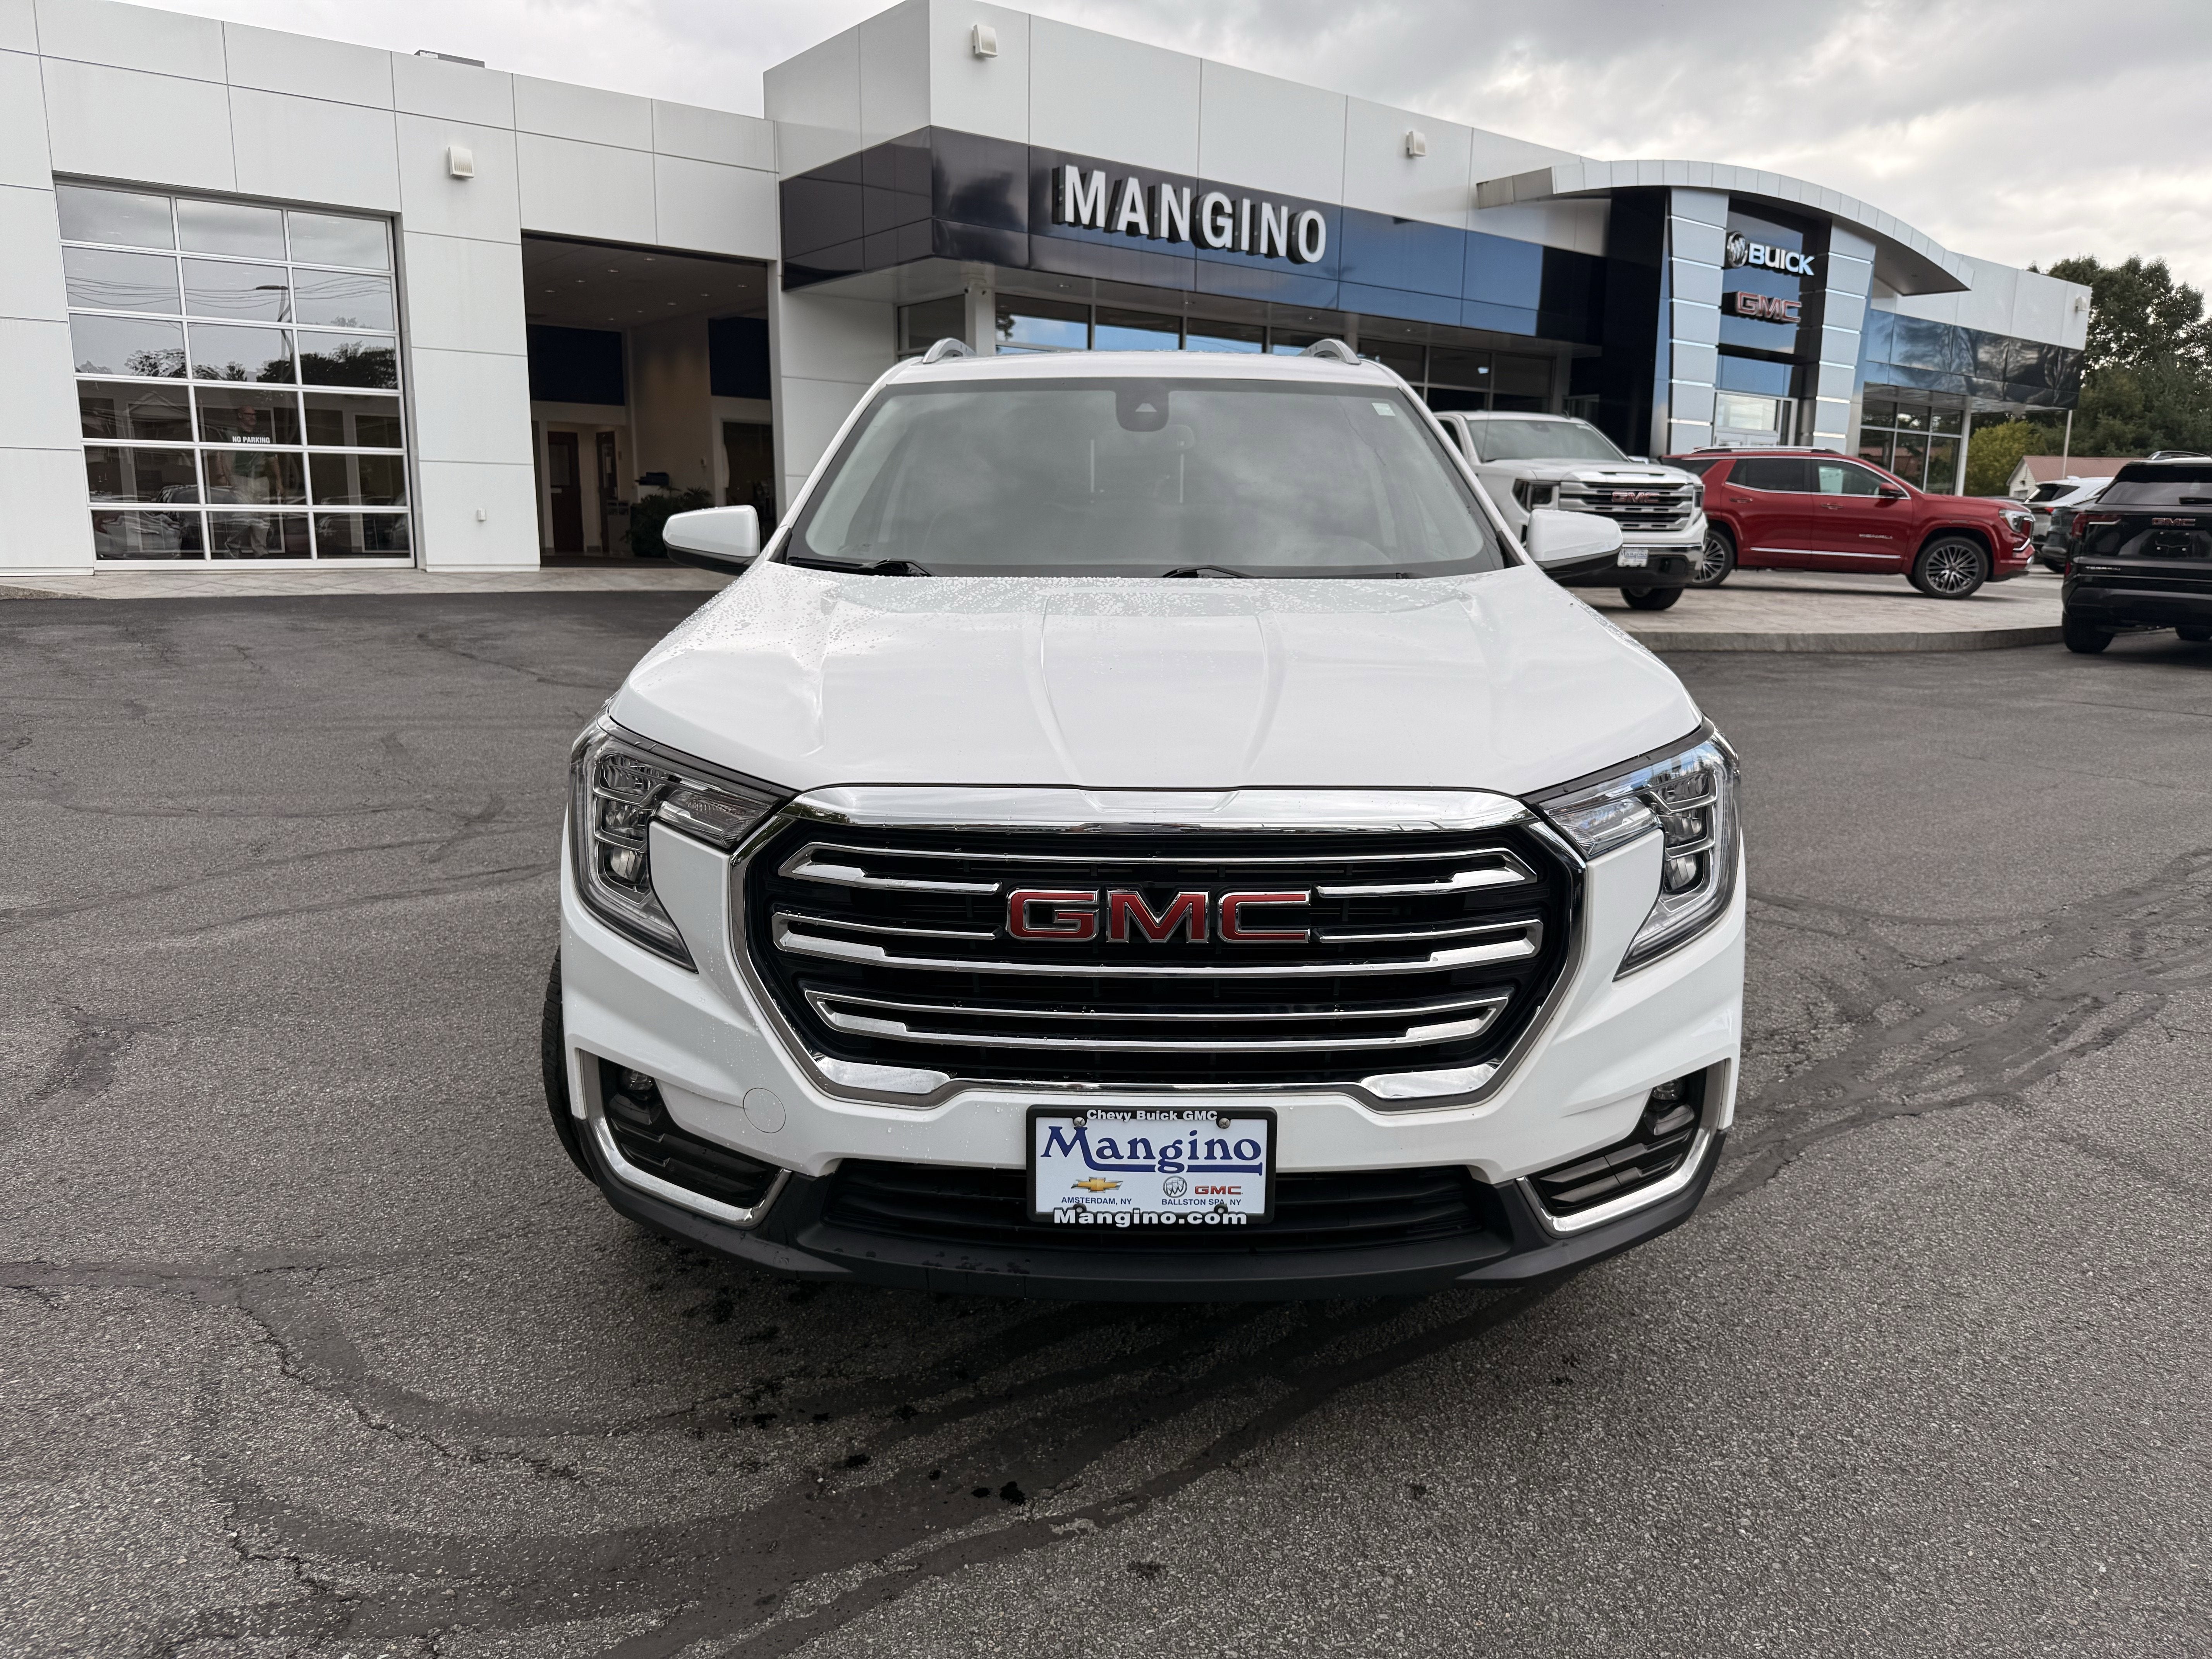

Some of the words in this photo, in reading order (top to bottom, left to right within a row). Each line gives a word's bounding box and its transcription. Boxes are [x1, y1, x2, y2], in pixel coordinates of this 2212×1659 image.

[1064, 164, 1326, 263] MANGINO
[1748, 242, 1815, 276] BUICK
[1736, 291, 1802, 323] GMC
[1611, 491, 1660, 503] GMC
[2152, 517, 2196, 527] GMC
[1006, 889, 1311, 944] GMC
[1087, 1109, 1132, 1122] Chevy
[1136, 1110, 1178, 1120] Buick
[1183, 1110, 1218, 1121] GMC
[1040, 1126, 1262, 1175] Mangino
[1195, 1185, 1242, 1195] GMC
[1061, 1197, 1118, 1206] AMSTERDAM,
[1054, 1209, 1247, 1228] Mangino.com
